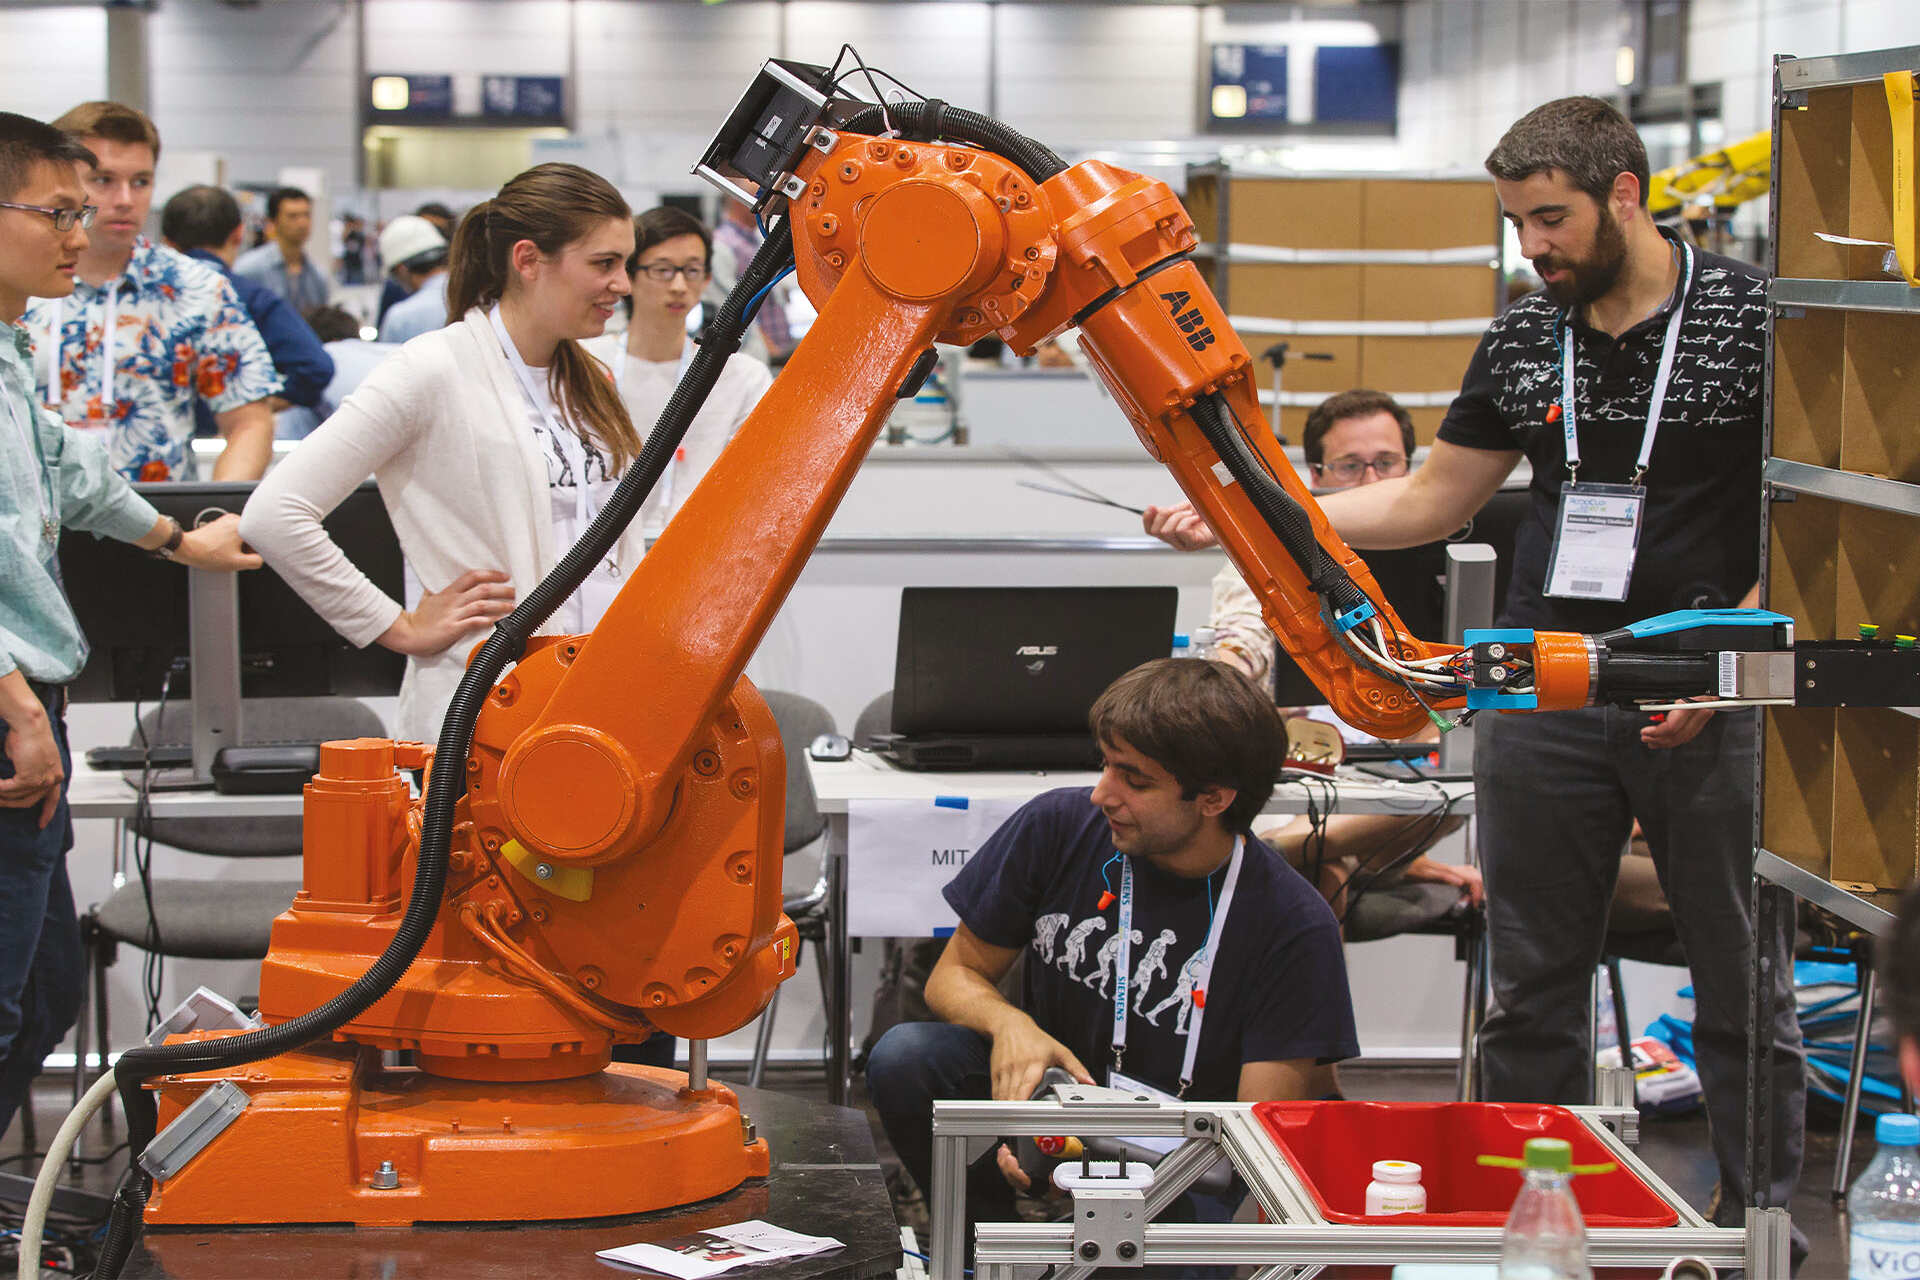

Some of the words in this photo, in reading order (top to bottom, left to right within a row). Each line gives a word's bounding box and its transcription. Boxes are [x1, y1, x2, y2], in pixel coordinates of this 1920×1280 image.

[1159, 290, 1216, 352] ABB
[1566, 398, 1575, 440] SIEMENS
[1016, 645, 1058, 656] ASUS
[932, 849, 970, 865] MIT
[1117, 976, 1126, 1022] SIEMENS
